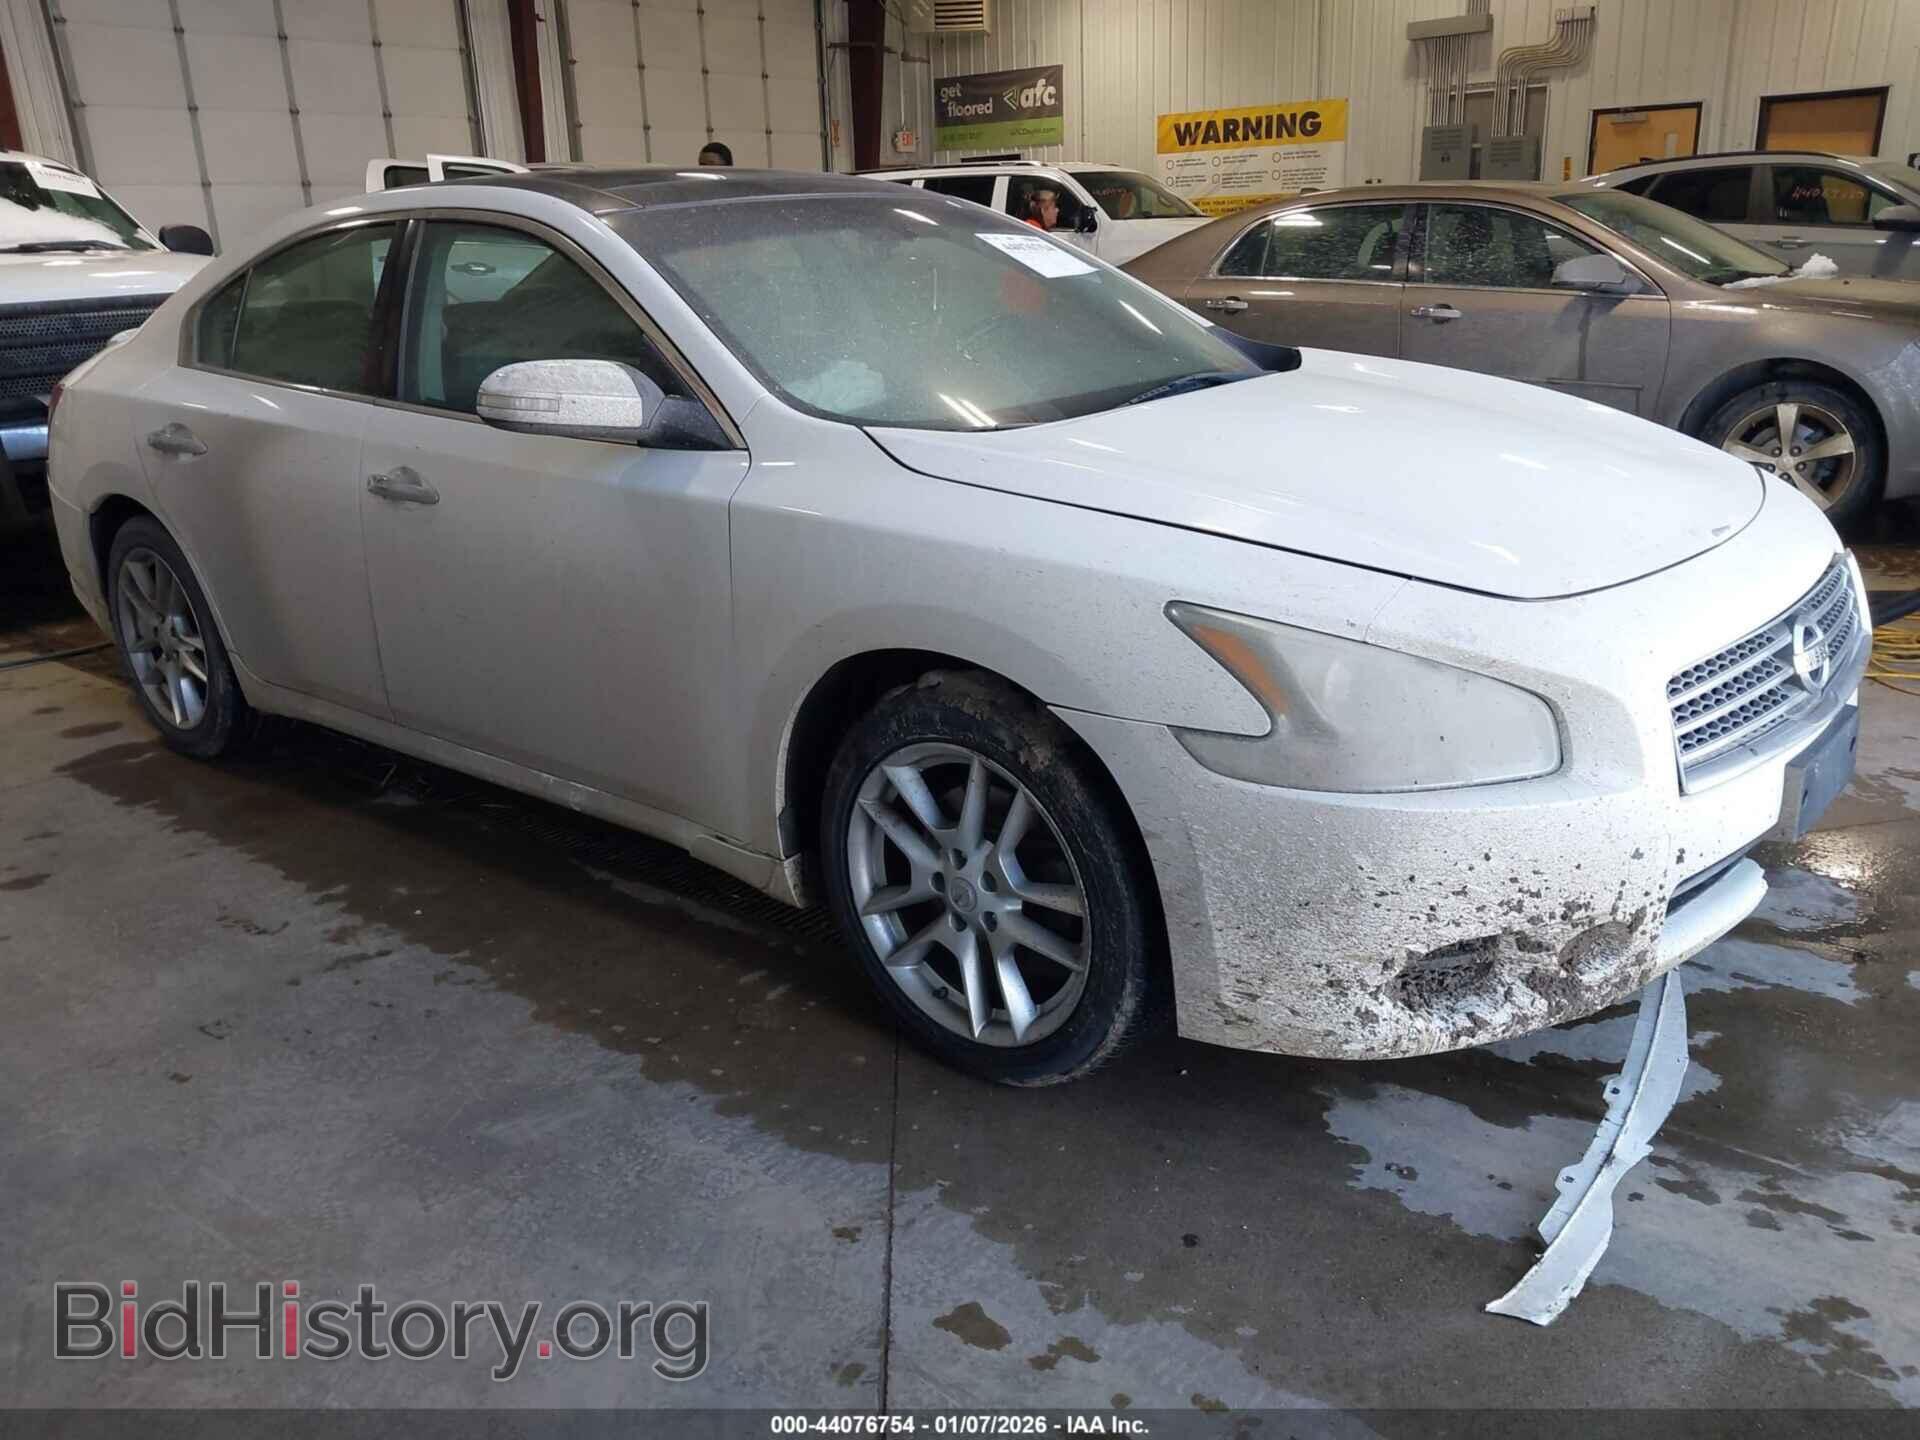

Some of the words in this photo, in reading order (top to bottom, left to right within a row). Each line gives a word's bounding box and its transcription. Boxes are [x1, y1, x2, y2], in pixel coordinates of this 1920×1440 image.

[940, 83, 962, 102] get
[1020, 79, 1057, 108] afc
[947, 97, 993, 118] floored
[1174, 111, 1322, 147] WARNING
